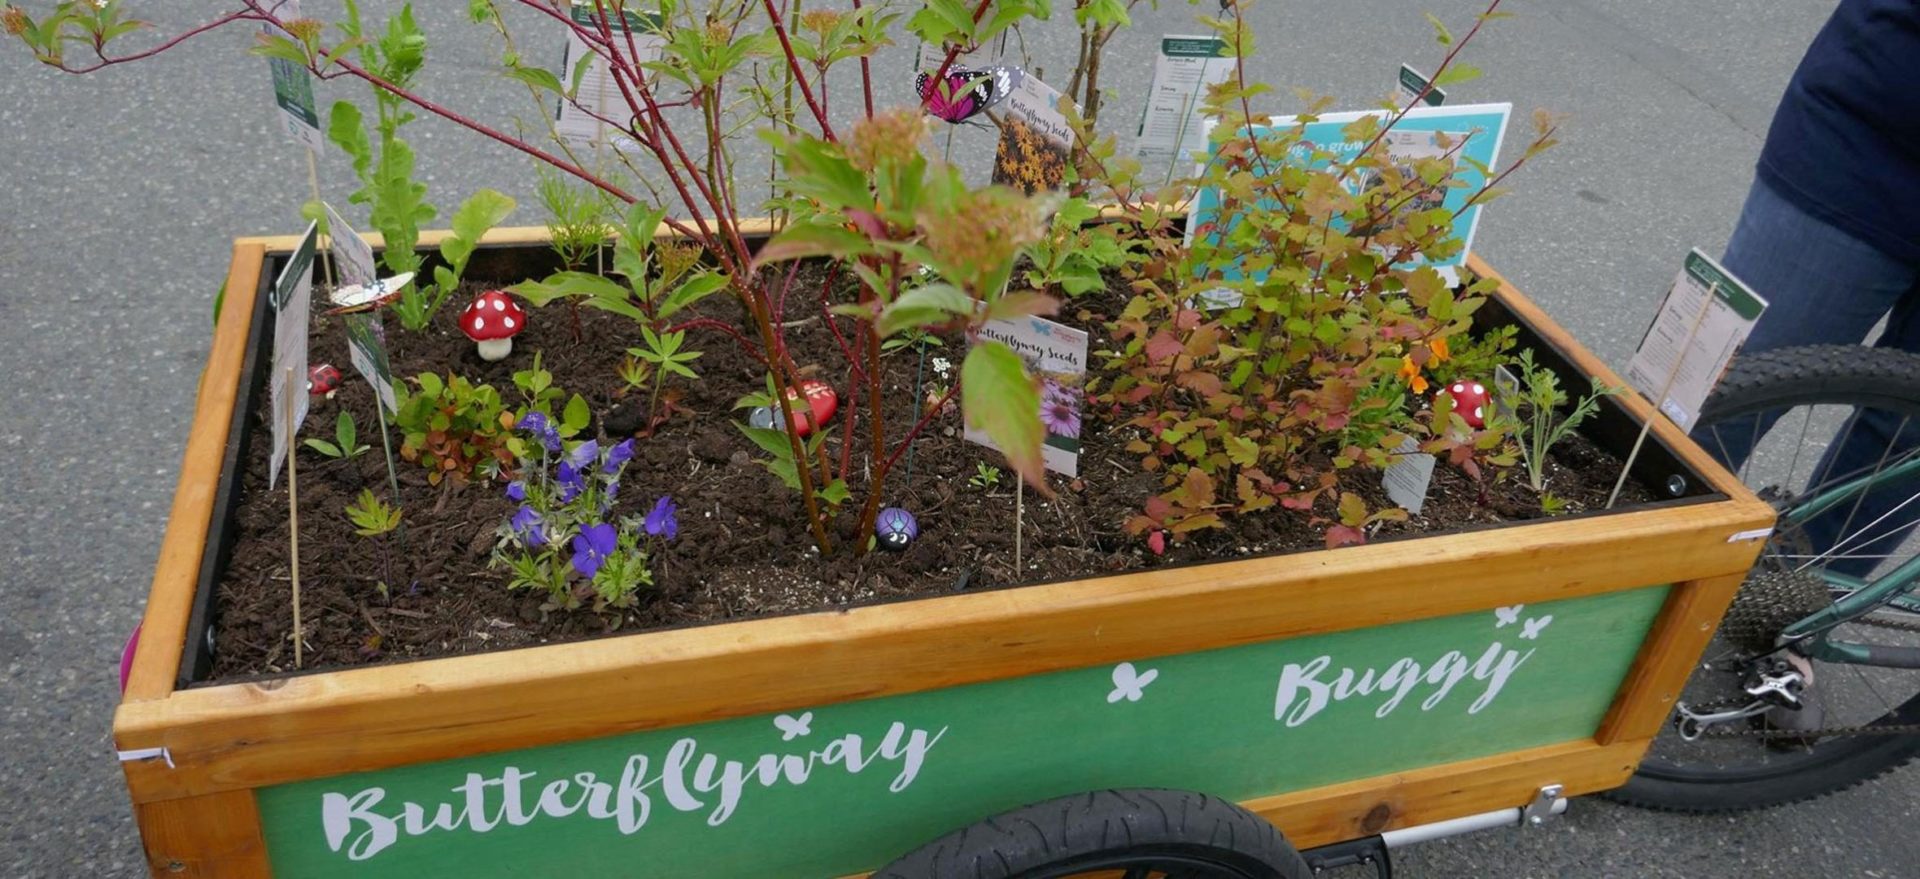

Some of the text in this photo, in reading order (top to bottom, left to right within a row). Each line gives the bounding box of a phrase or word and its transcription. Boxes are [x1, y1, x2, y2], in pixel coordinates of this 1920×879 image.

[1010, 97, 1069, 142] Butterflyway Seeds
[1048, 346, 1078, 366] Seeds
[1274, 641, 1536, 727] Buggy
[322, 721, 948, 861] Butterflyway
